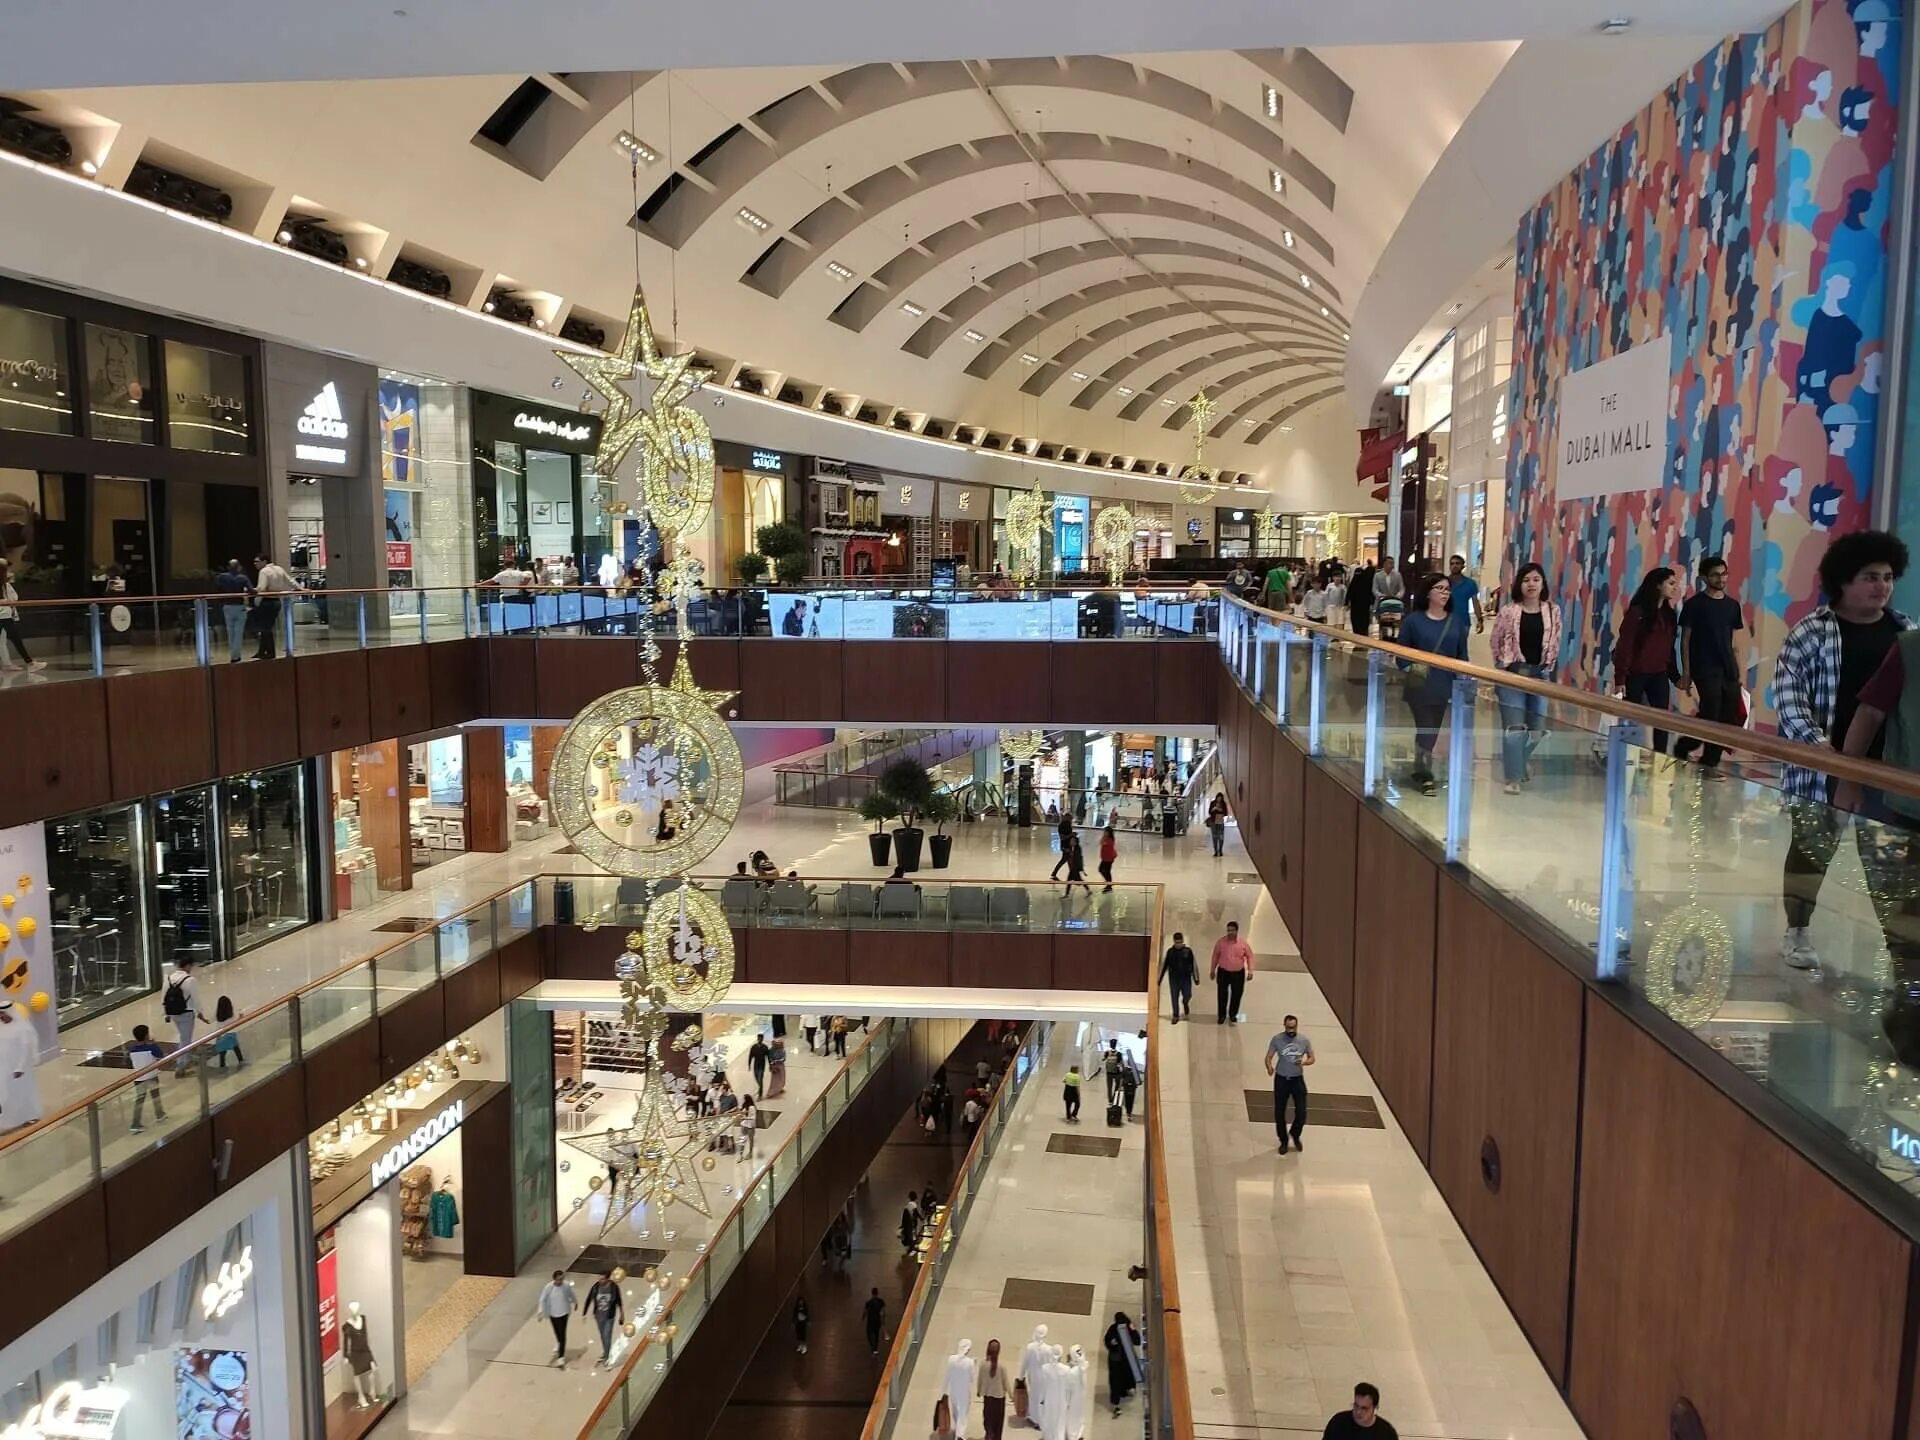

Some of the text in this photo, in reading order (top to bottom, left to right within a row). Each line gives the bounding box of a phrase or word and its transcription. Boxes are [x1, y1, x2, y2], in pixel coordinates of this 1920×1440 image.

[1600, 393, 1617, 414] THE
[297, 416, 348, 439] adidas
[1567, 421, 1651, 465] DUBAI MALL
[395, 551, 406, 564] OFF
[371, 1099, 463, 1188] MONSOON
